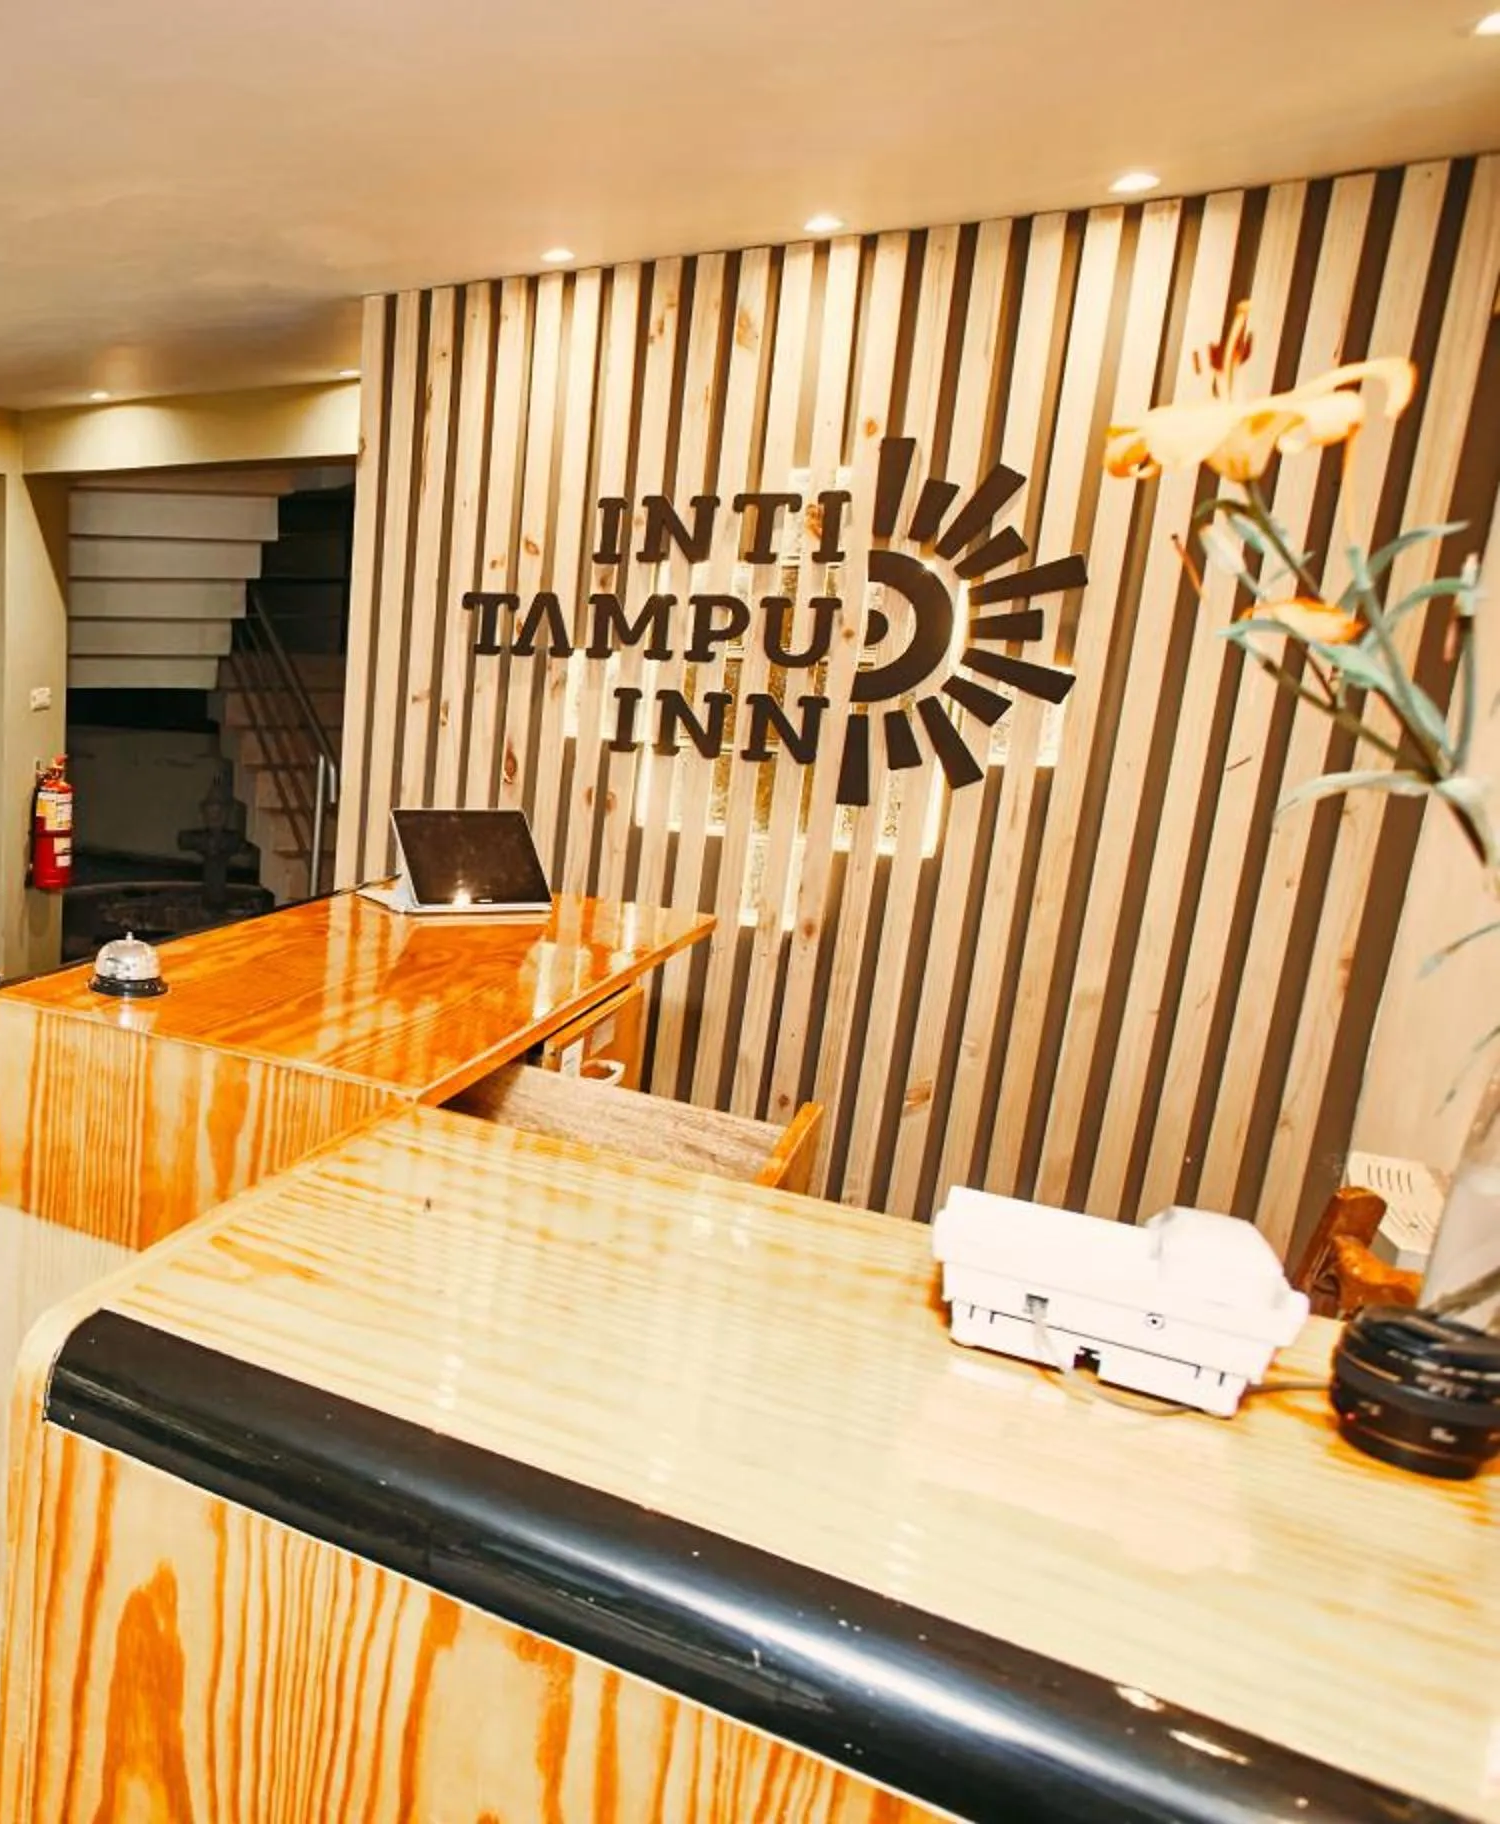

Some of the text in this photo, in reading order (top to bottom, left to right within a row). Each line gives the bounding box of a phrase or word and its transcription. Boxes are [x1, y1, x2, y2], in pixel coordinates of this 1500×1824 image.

[594, 491, 852, 563] INTI
[463, 591, 842, 668] TAMPU
[609, 687, 830, 764] INN
